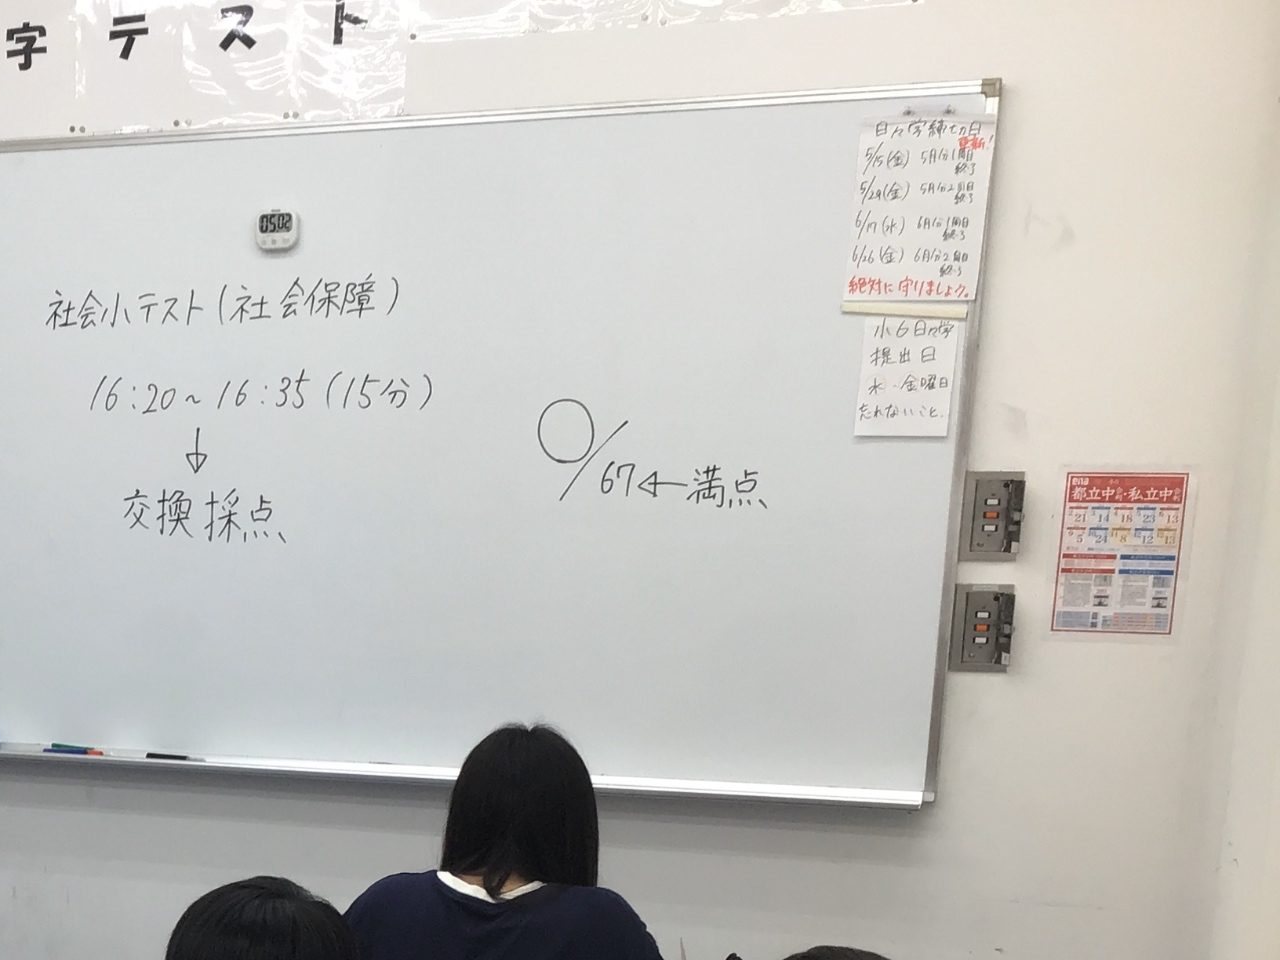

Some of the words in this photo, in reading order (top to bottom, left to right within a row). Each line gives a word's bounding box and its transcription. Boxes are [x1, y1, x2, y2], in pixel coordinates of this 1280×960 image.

[870, 346, 937, 368] 提出日
[687, 464, 768, 509] 満点
[123, 488, 287, 543] 交換採点
